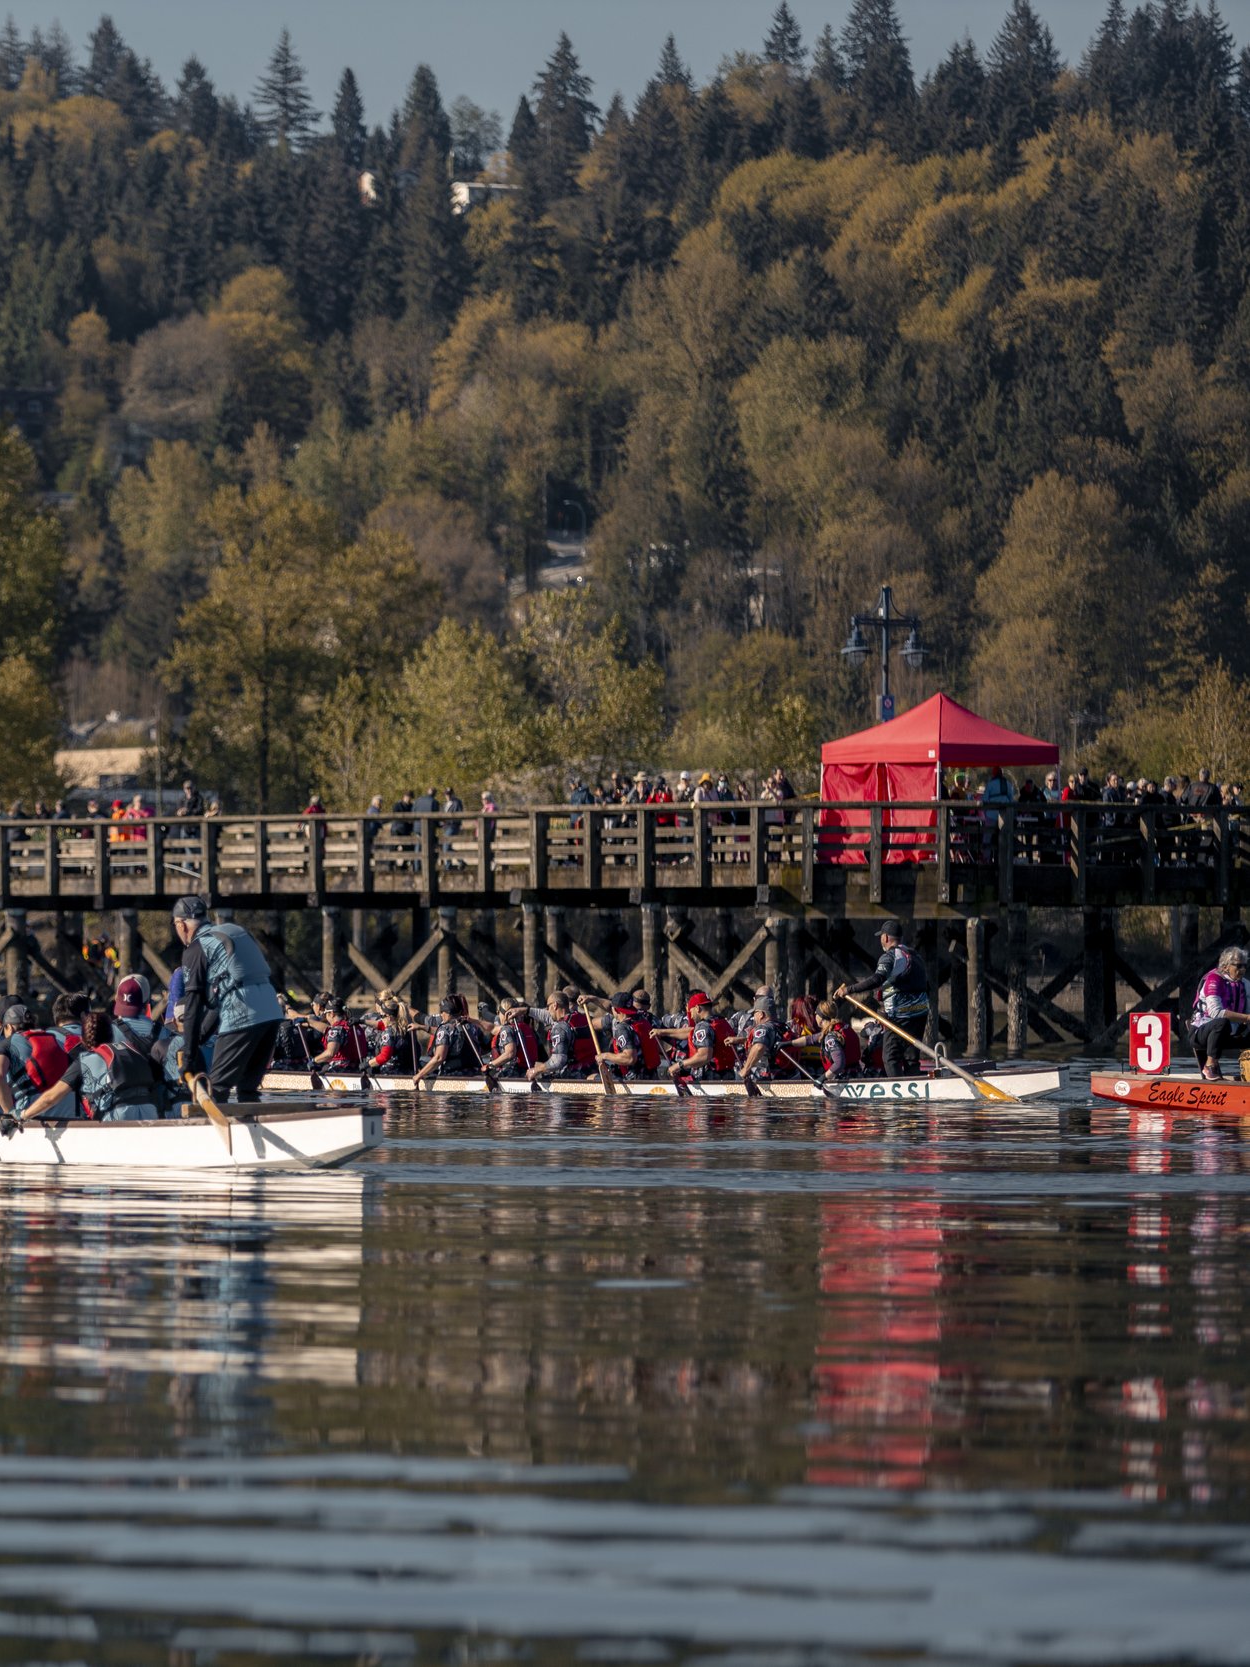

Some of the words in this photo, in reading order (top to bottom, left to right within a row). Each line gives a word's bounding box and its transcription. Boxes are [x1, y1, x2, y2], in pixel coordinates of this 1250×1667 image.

[1136, 1014, 1163, 1071] 3
[1148, 1081, 1184, 1106] Eagle
[1186, 1086, 1228, 1109] Spirit
